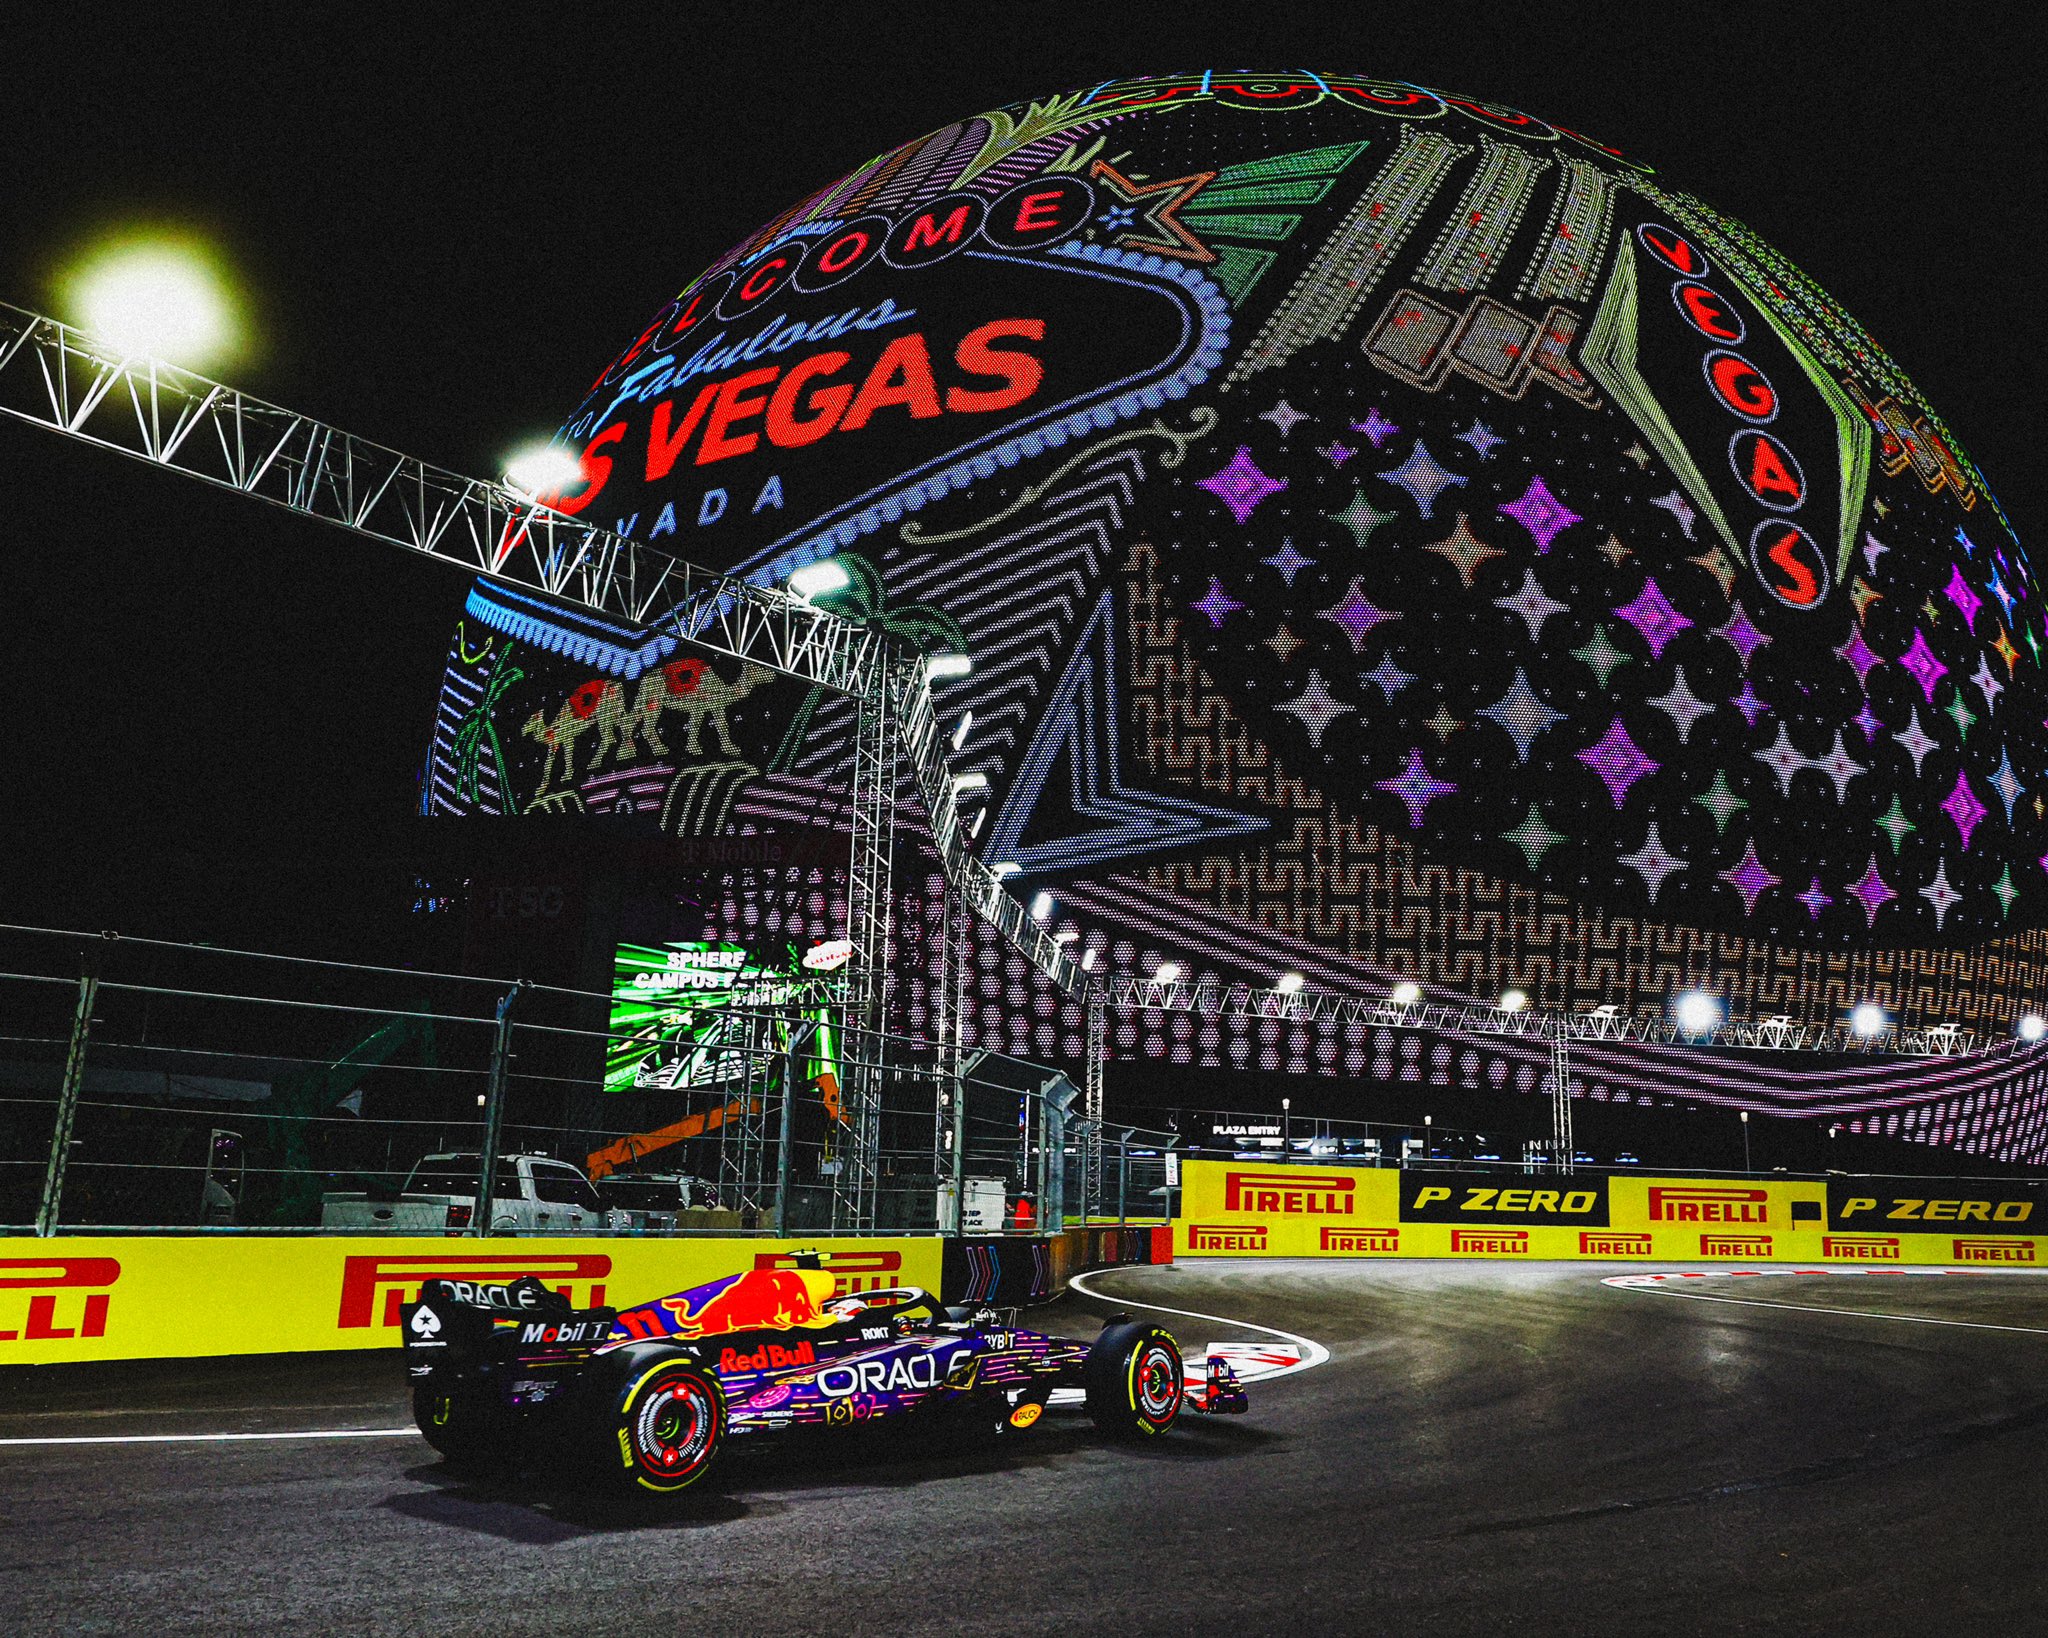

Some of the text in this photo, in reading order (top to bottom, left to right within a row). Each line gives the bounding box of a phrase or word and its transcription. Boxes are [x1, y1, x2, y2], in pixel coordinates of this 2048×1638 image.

[588, 190, 1064, 395] ELCOME
[590, 298, 917, 438] Fabulous
[645, 318, 1045, 482] VEGAS
[1645, 232, 1819, 605] VEGAS
[667, 951, 746, 968] SPHERE
[633, 972, 719, 989] CAMPUS
[1212, 1125, 1281, 1135] PLAZA ENTRY
[1226, 1172, 1356, 1214] PIRELLI
[1412, 1187, 1598, 1213] P ZERO
[1648, 1187, 1768, 1223] PIRELLI
[1840, 1198, 2034, 1222] P ZERO
[1188, 1225, 1268, 1250] PIRELLI
[1320, 1227, 1399, 1251] PIRELLI
[1451, 1229, 1529, 1253] PIRELLI
[1579, 1232, 1652, 1255] PIRELLI
[1700, 1234, 1773, 1256] PIRELLI
[1822, 1236, 1900, 1259] PIRELLI
[1953, 1239, 2035, 1262] PIRELLI
[440, 1280, 543, 1310] ORACLE
[521, 1321, 611, 1343] Mobil 1
[720, 1341, 816, 1374] Red Bull
[817, 1350, 973, 1398] ORACLE
[1208, 1364, 1230, 1378] Mobil
